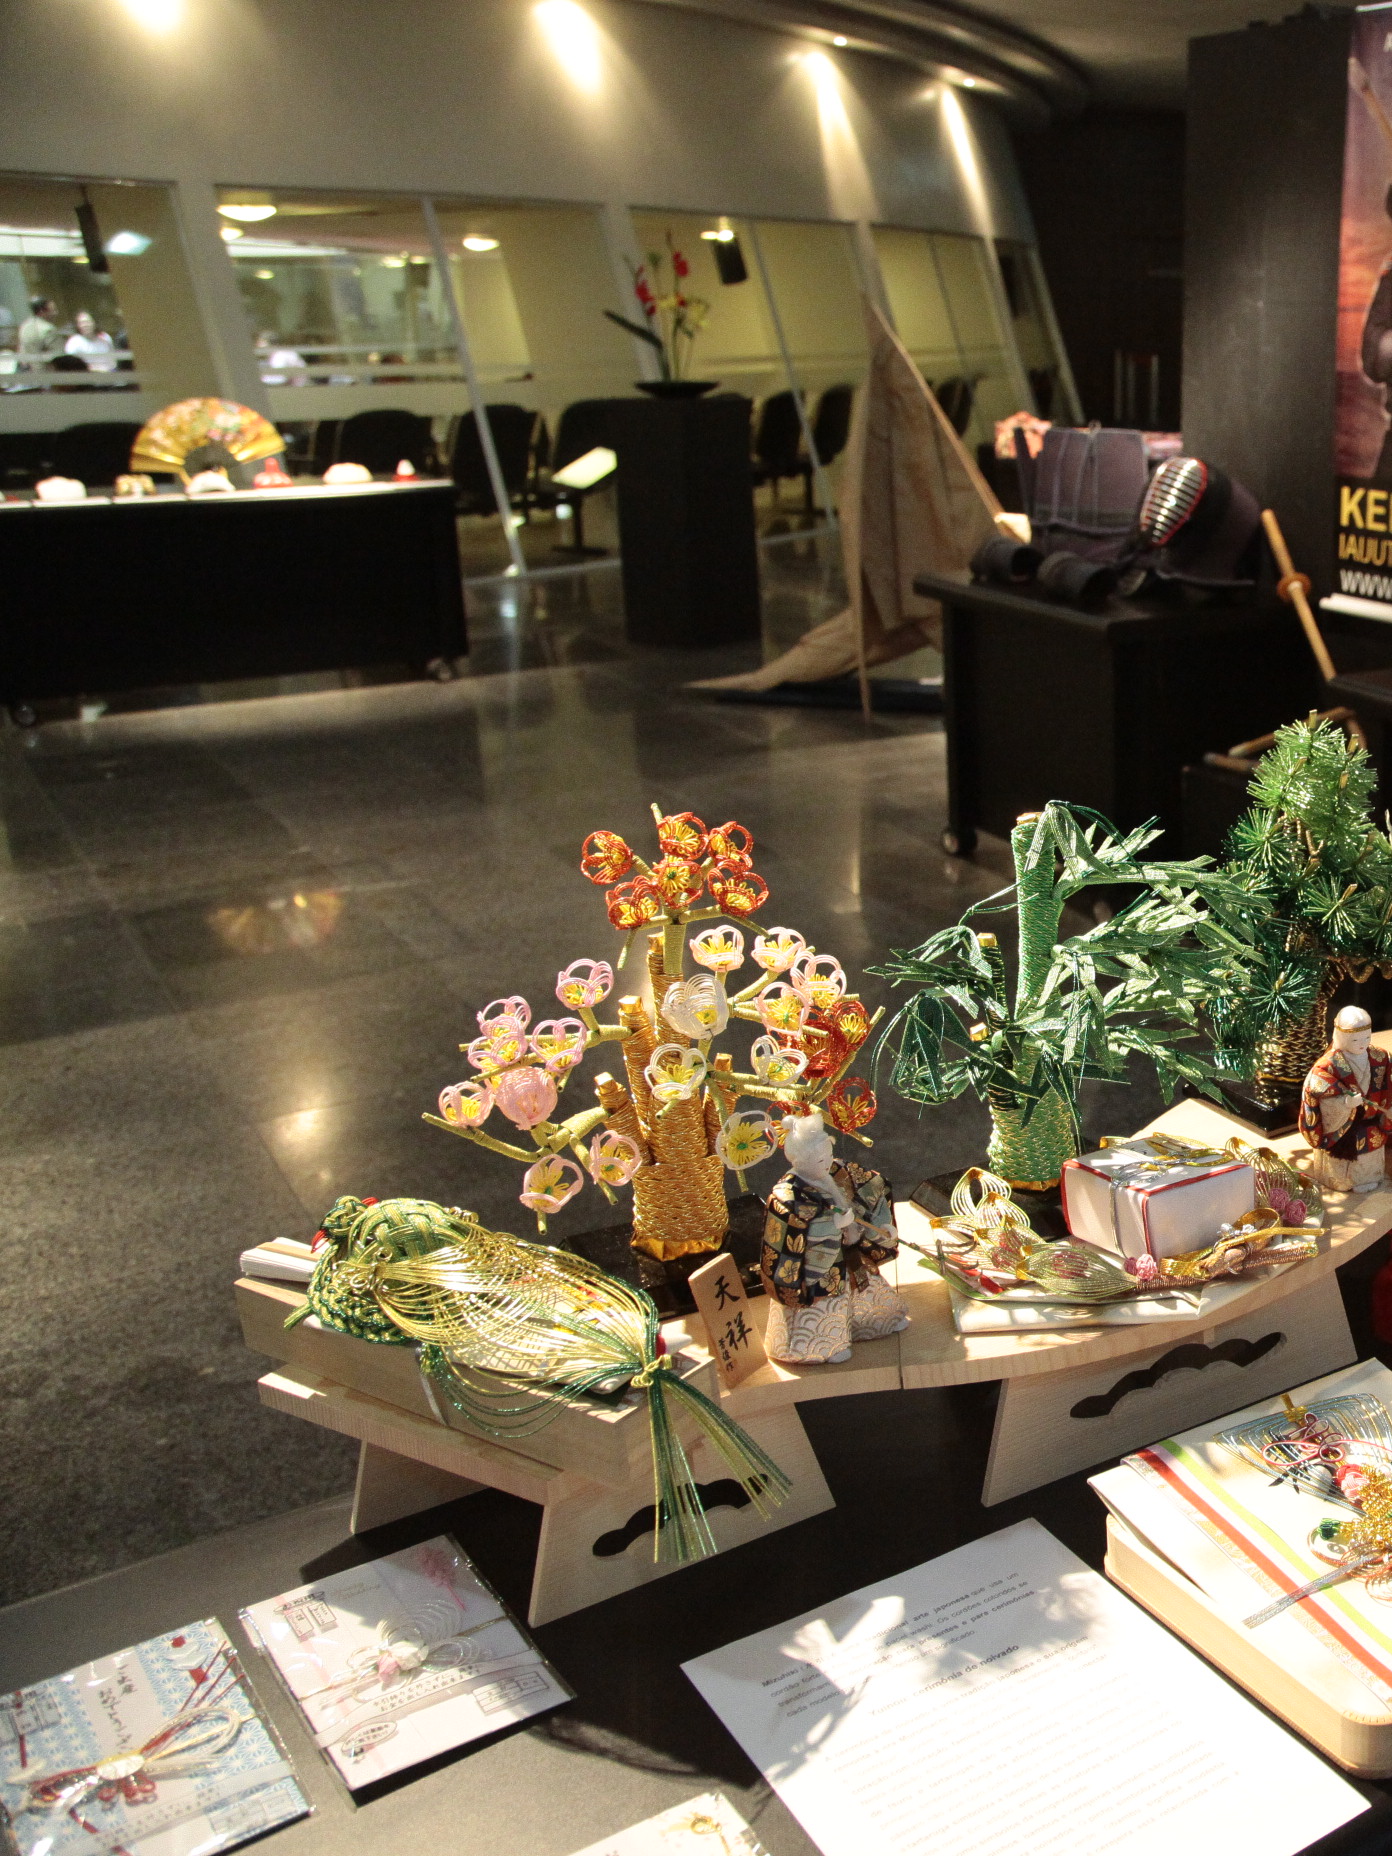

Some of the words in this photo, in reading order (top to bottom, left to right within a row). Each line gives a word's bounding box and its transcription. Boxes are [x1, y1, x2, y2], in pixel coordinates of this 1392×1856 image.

[911, 1611, 929, 1621] arte
[933, 1594, 970, 1612] japonesa
[970, 1587, 986, 1596] que
[989, 1579, 1004, 1588] usa
[1006, 1572, 1020, 1580] um
[801, 1672, 820, 1683] forte
[936, 1615, 949, 1624] Os
[950, 1601, 981, 1617] cordões
[918, 1624, 959, 1645] presentes
[970, 1611, 989, 1622] para
[911, 1671, 963, 1697] cerimônia
[964, 1664, 978, 1673] de
[979, 1645, 1020, 1666] noivado
